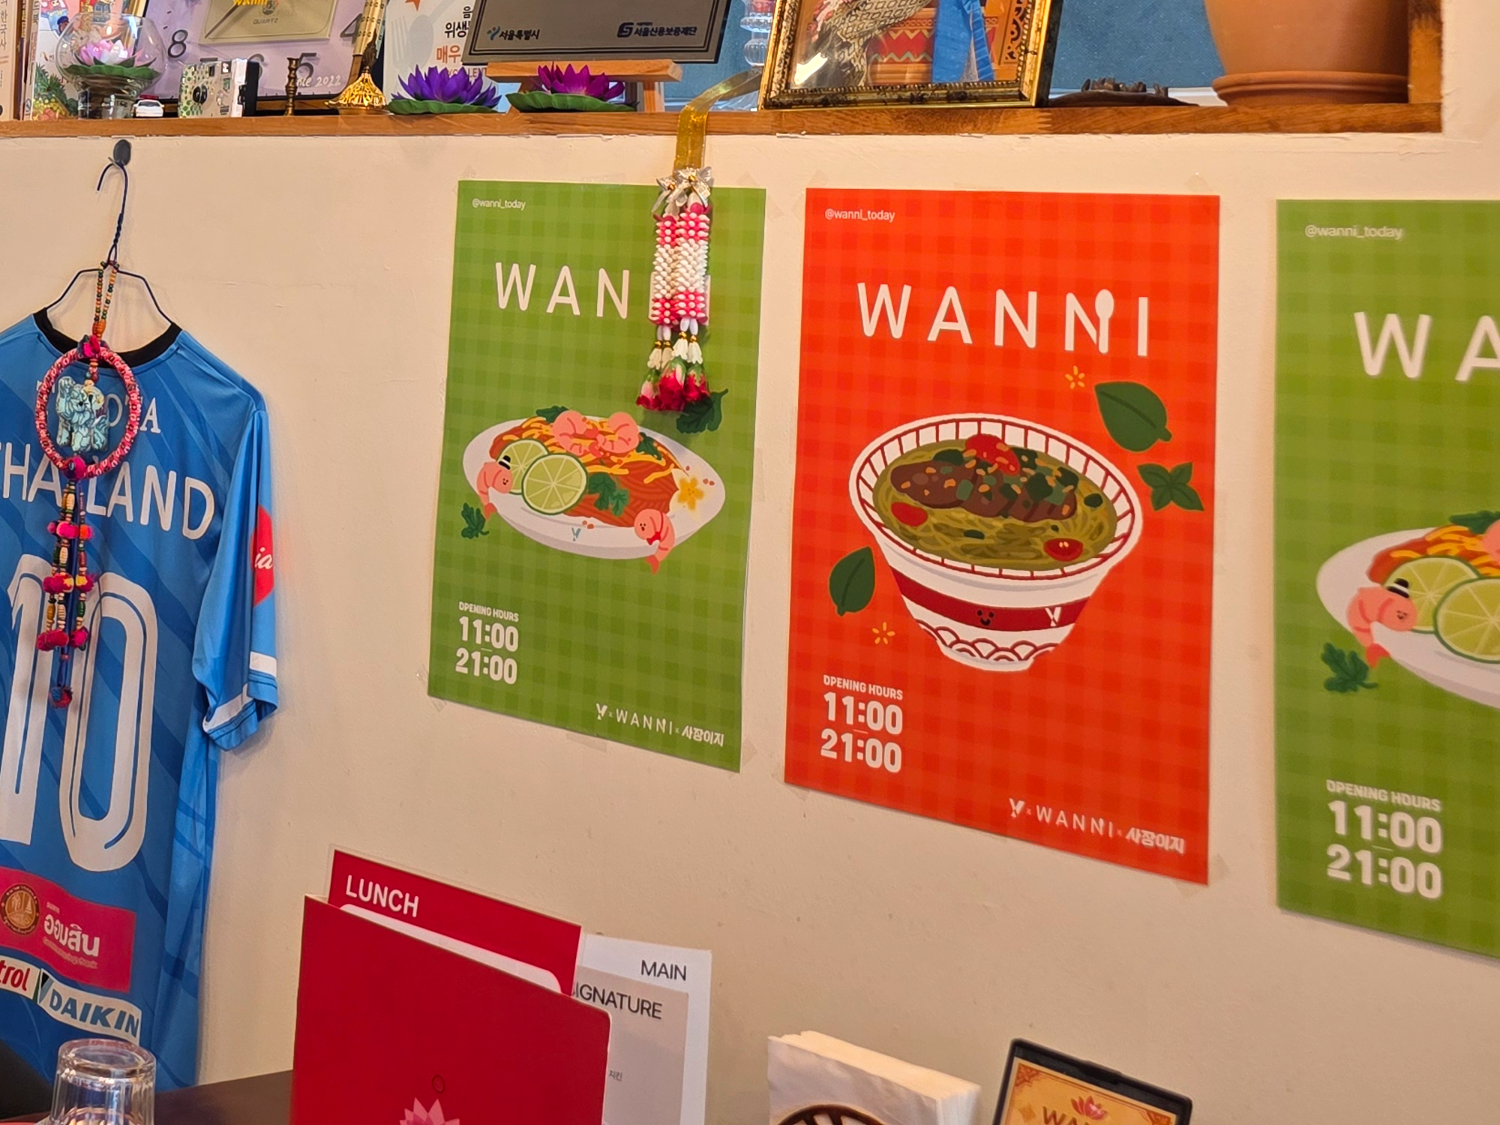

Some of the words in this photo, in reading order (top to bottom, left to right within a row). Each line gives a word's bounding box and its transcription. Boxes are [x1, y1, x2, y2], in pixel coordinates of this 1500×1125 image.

[167, 29, 188, 58] 8
[436, 45, 462, 64] 매우
[316, 76, 342, 87] 2022
[472, 197, 526, 211] @wanni_today
[824, 208, 896, 224] @wanni_today
[1304, 224, 1404, 241] @wanni_today
[856, 281, 1149, 357] WANNI
[458, 600, 492, 618] OPENING
[492, 607, 519, 623] HOURS
[458, 616, 519, 652] 11:00
[455, 648, 518, 685] 21:00
[823, 674, 867, 694] OPENING
[868, 683, 904, 701] HOURS
[616, 708, 673, 736] WANNI
[823, 691, 904, 735] 11:00
[820, 728, 903, 773] 21:00
[1326, 779, 1388, 801] OPENING
[1391, 791, 1442, 812] HOURS
[1035, 804, 1113, 838] WANNI
[1328, 800, 1443, 854] 11:00
[1326, 843, 1443, 900] 21:00
[345, 874, 420, 918] LUNCH
[43, 914, 101, 957] ออมสิน
[640, 959, 688, 982] MAIN
[48, 989, 140, 1038] DAIKIN
